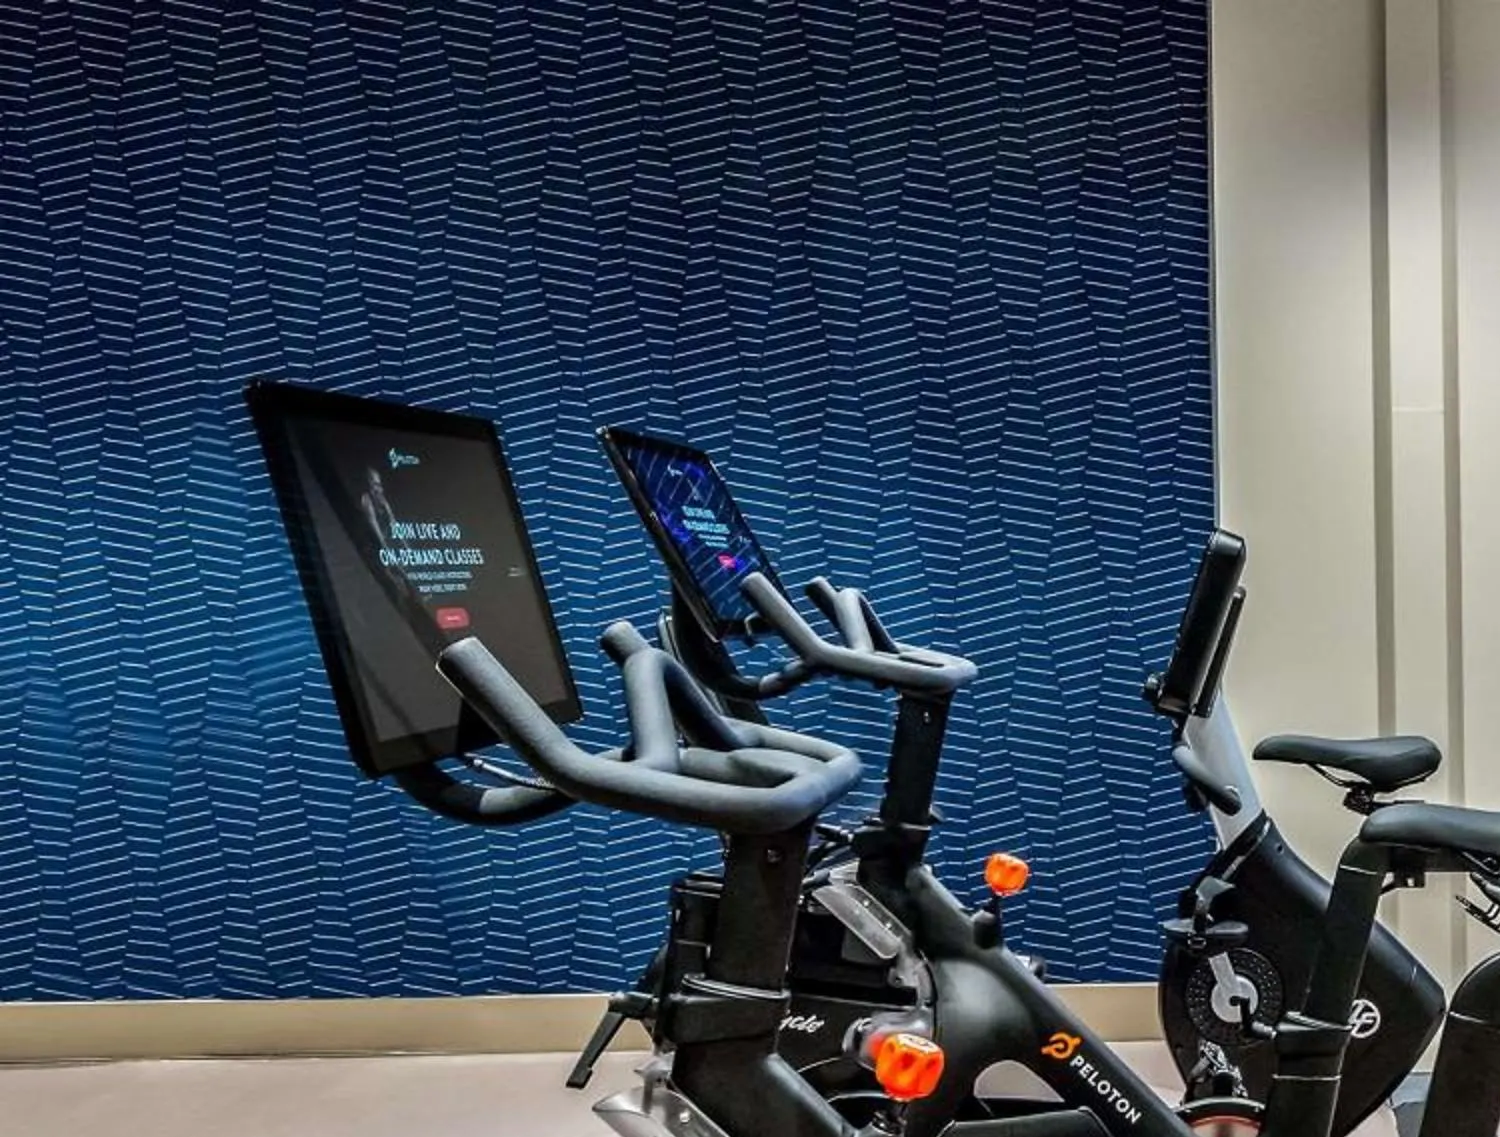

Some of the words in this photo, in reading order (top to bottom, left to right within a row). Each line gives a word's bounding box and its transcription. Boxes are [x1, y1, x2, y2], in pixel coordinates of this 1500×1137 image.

[391, 522, 415, 540] JOIN
[416, 523, 438, 541] LIVE
[440, 524, 461, 541] AND
[379, 548, 443, 566] ON-DEMAND
[446, 548, 485, 565] CLASSES
[1069, 1054, 1143, 1125] PELOTON
